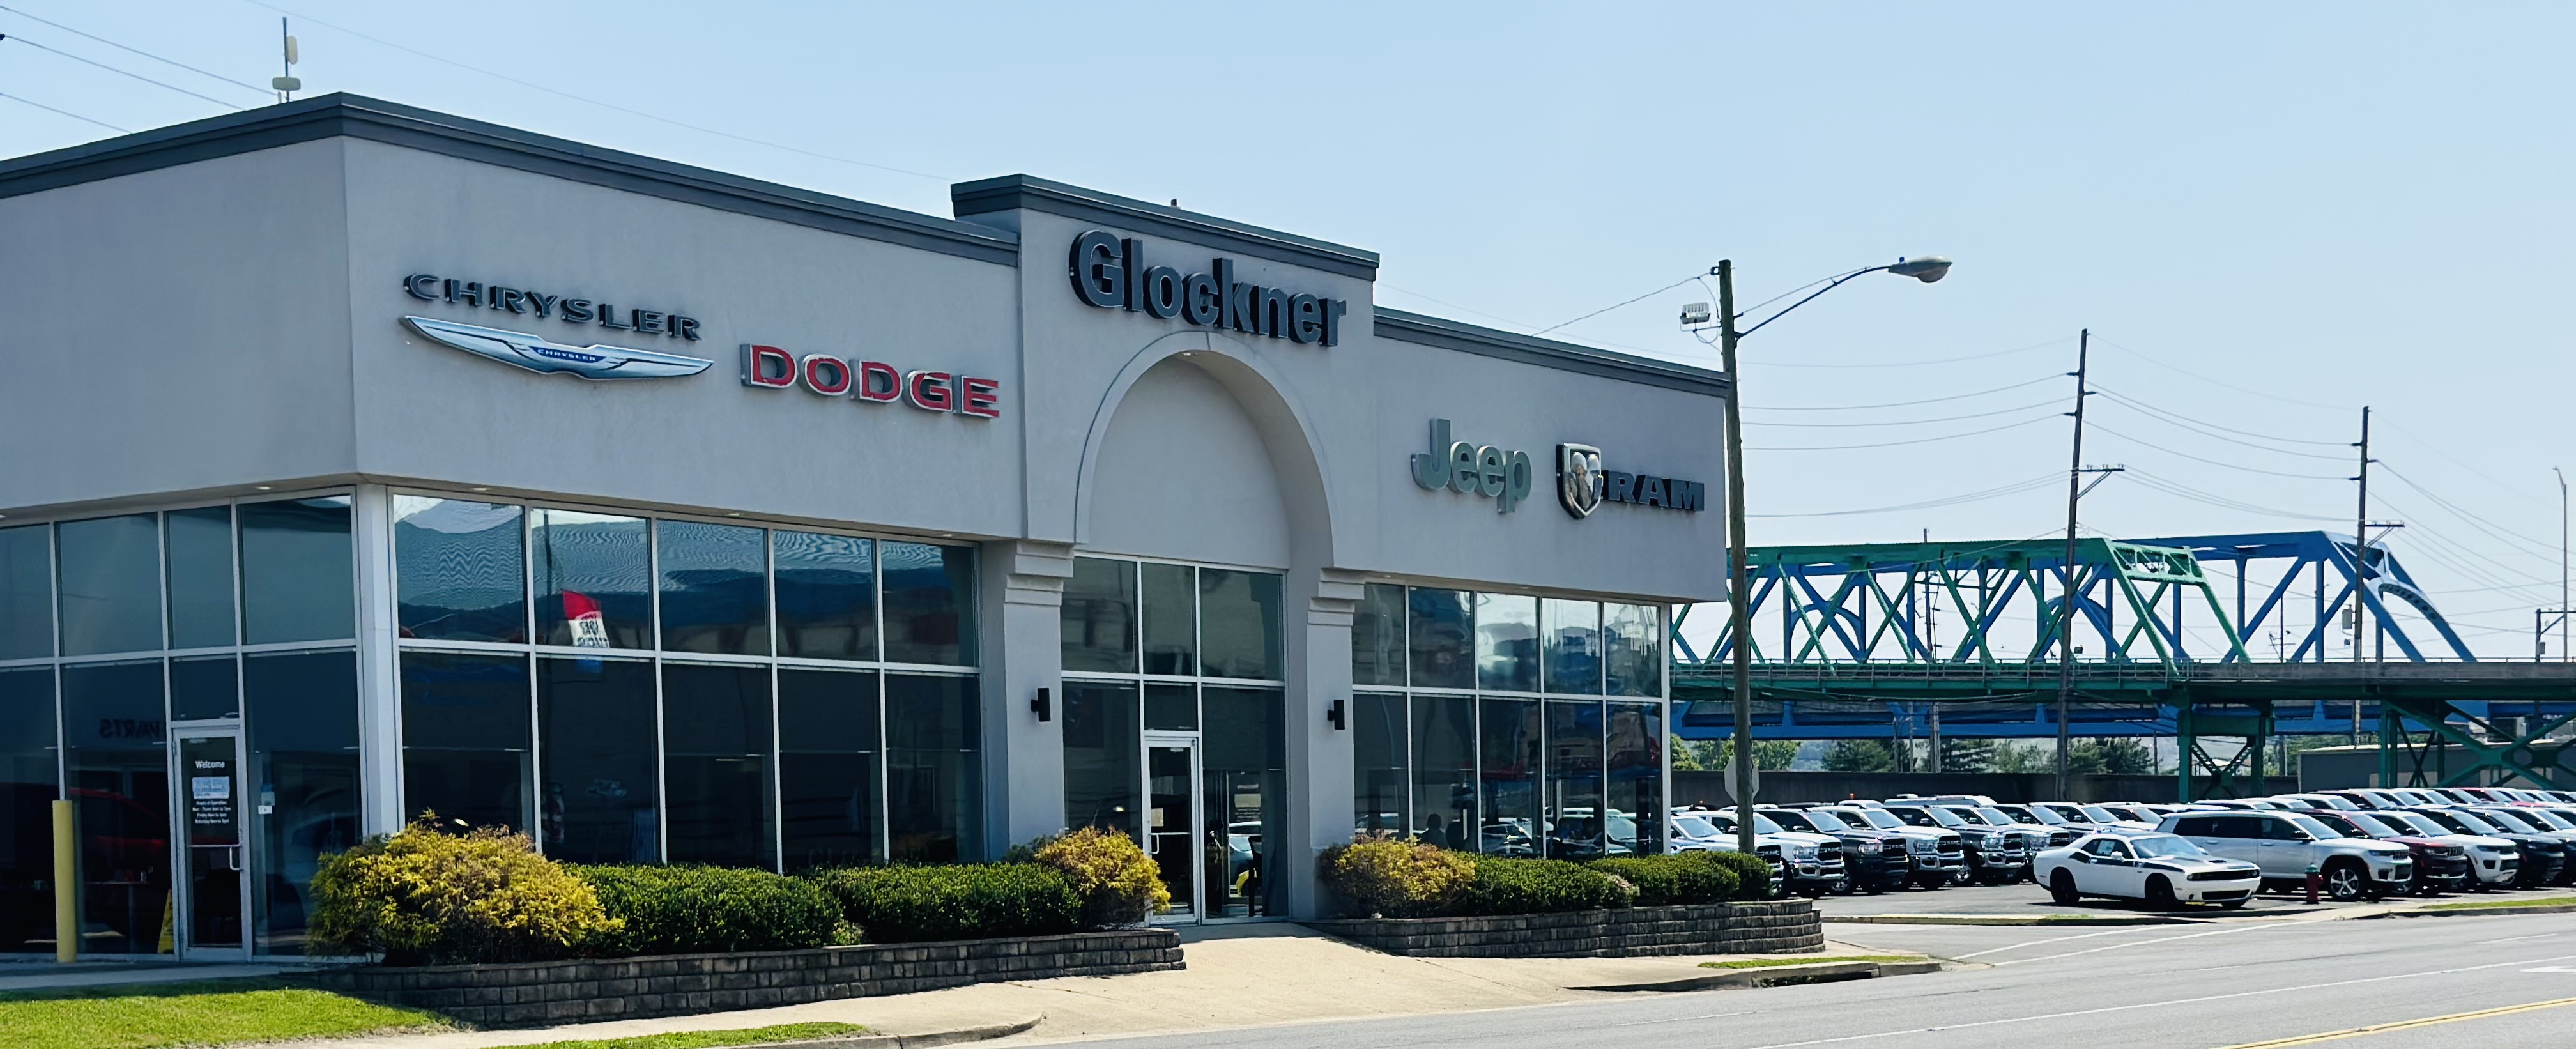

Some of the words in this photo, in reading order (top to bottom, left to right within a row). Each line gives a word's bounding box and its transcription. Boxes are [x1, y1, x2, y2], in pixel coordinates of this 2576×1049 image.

[403, 273, 702, 341] CHRYSLER
[1069, 230, 1346, 347] Glockner
[537, 349, 595, 361] CHRYSLER
[740, 343, 1000, 419] DODGE
[1411, 418, 1532, 514] Jeep
[1601, 469, 1705, 511] RAM
[195, 760, 225, 769] Welcome
